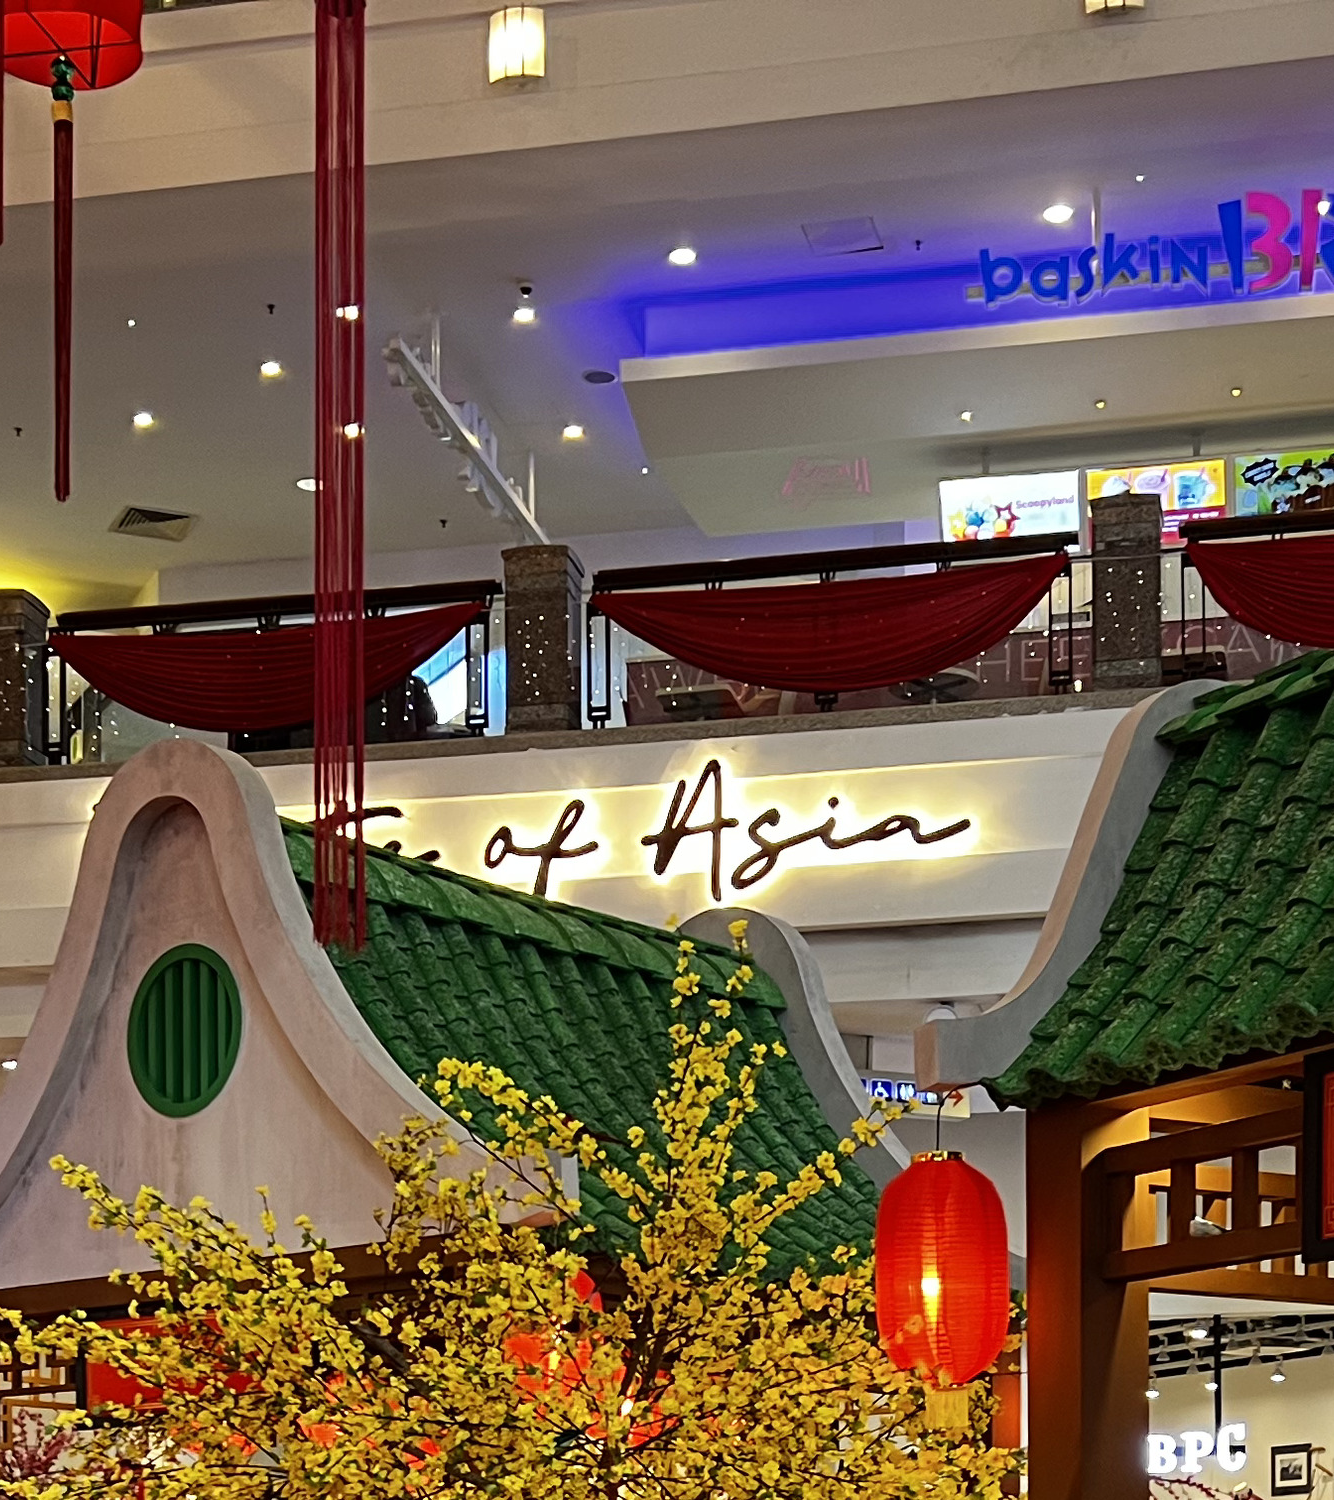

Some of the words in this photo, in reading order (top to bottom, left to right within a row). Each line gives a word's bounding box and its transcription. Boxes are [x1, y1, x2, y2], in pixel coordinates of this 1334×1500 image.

[484, 799, 599, 894] of
[641, 758, 971, 902] Asia
[1147, 1422, 1247, 1473] BPC
